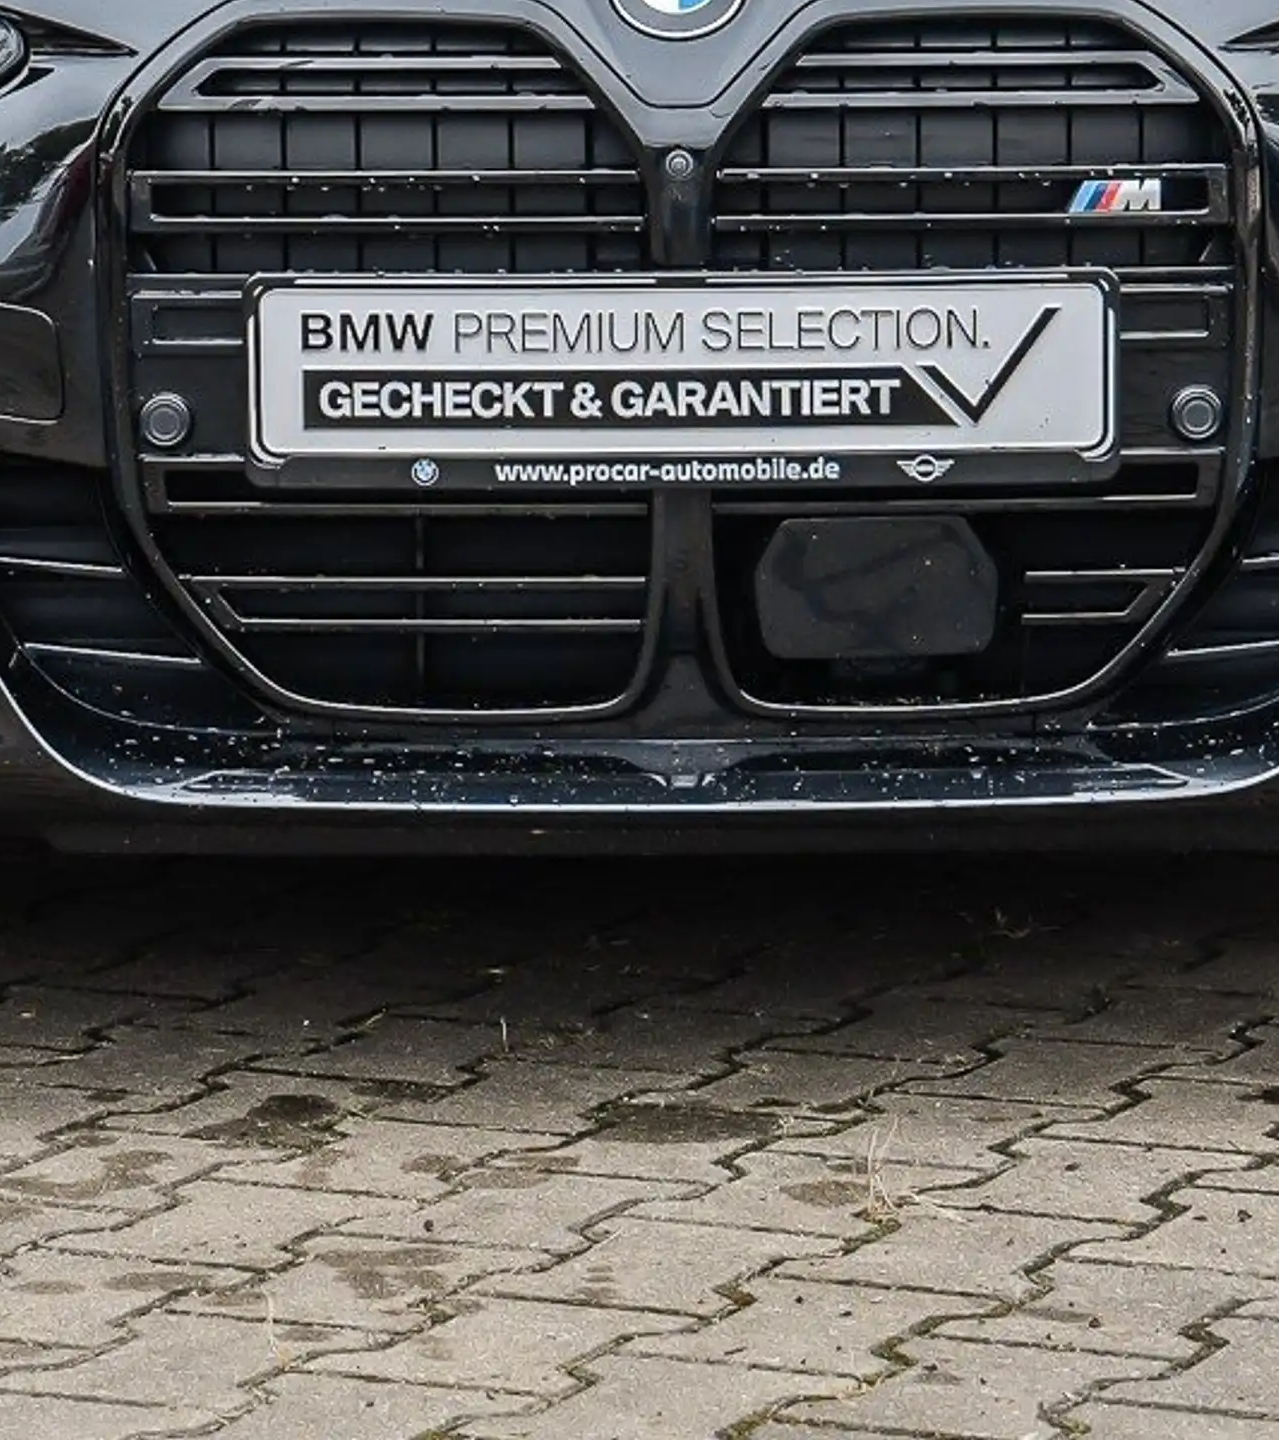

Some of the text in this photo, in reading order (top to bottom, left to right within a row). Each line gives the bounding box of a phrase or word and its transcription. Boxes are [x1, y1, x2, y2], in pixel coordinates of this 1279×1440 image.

[300, 307, 991, 354] BMW PREMIUM SELECTION.
[319, 377, 901, 419] GECHECKT & GARANTIERT
[494, 456, 841, 486] www.procar-automobile.de
